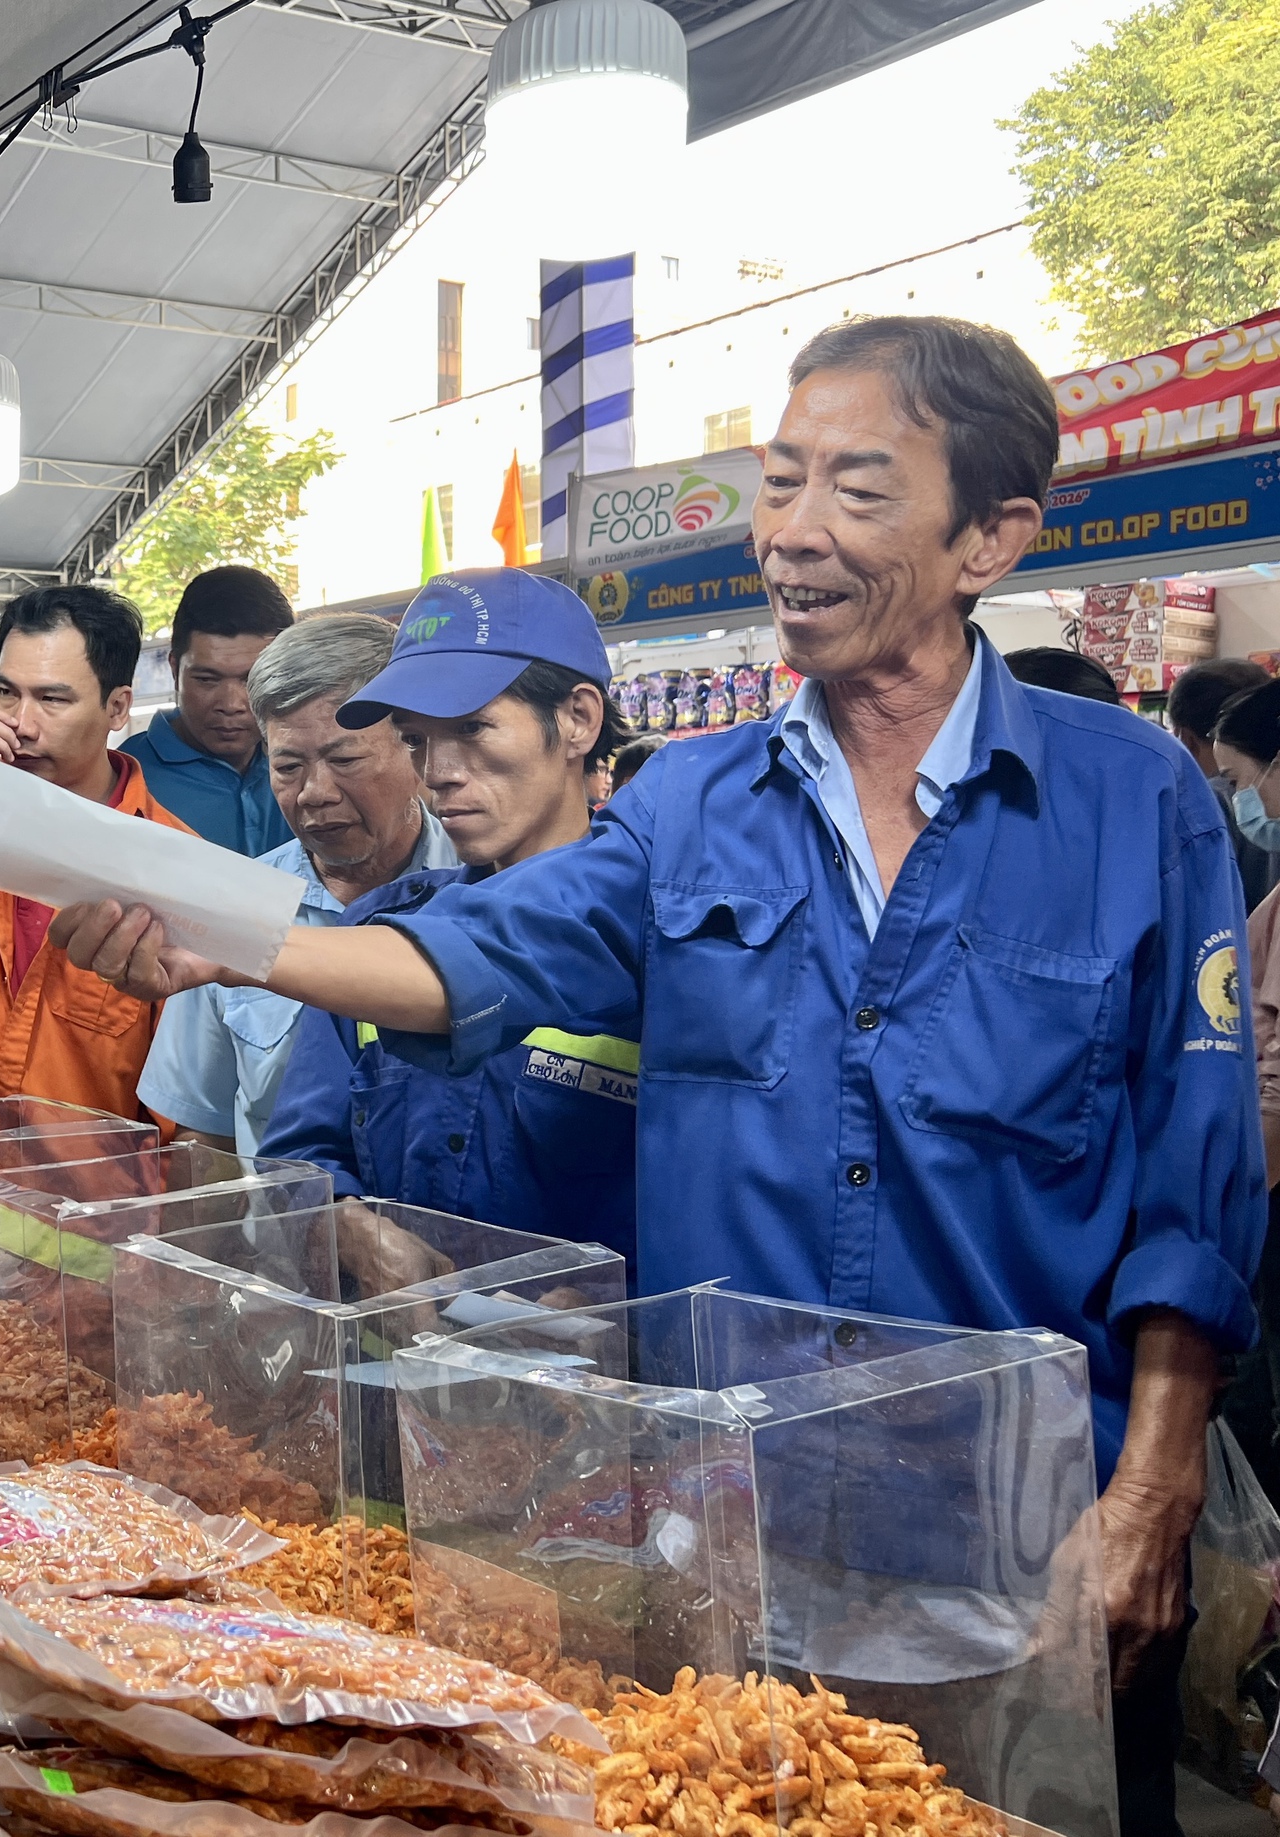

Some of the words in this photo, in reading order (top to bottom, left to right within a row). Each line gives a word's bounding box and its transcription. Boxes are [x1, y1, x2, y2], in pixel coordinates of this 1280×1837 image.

[1054, 354, 1180, 416] OOD
[1181, 320, 1280, 379] CÙN
[1052, 426, 1109, 478] M
[1111, 395, 1243, 465] TÌNH
[1249, 384, 1280, 437] T
[588, 511, 671, 547] FOOD
[1026, 526, 1072, 554] ON
[1081, 513, 1161, 546] CO.OP
[1170, 500, 1248, 533] FOOD
[588, 556, 601, 566] an
[647, 581, 694, 609] CÔNG
[699, 579, 722, 600] TY
[727, 573, 767, 597] TNH
[1090, 587, 1129, 601] KOKOMI
[475, 608, 490, 645] TP.HCM
[1090, 615, 1129, 630] KOKOMI
[1088, 641, 1127, 655] KOKOMI
[546, 1054, 566, 1068] CN
